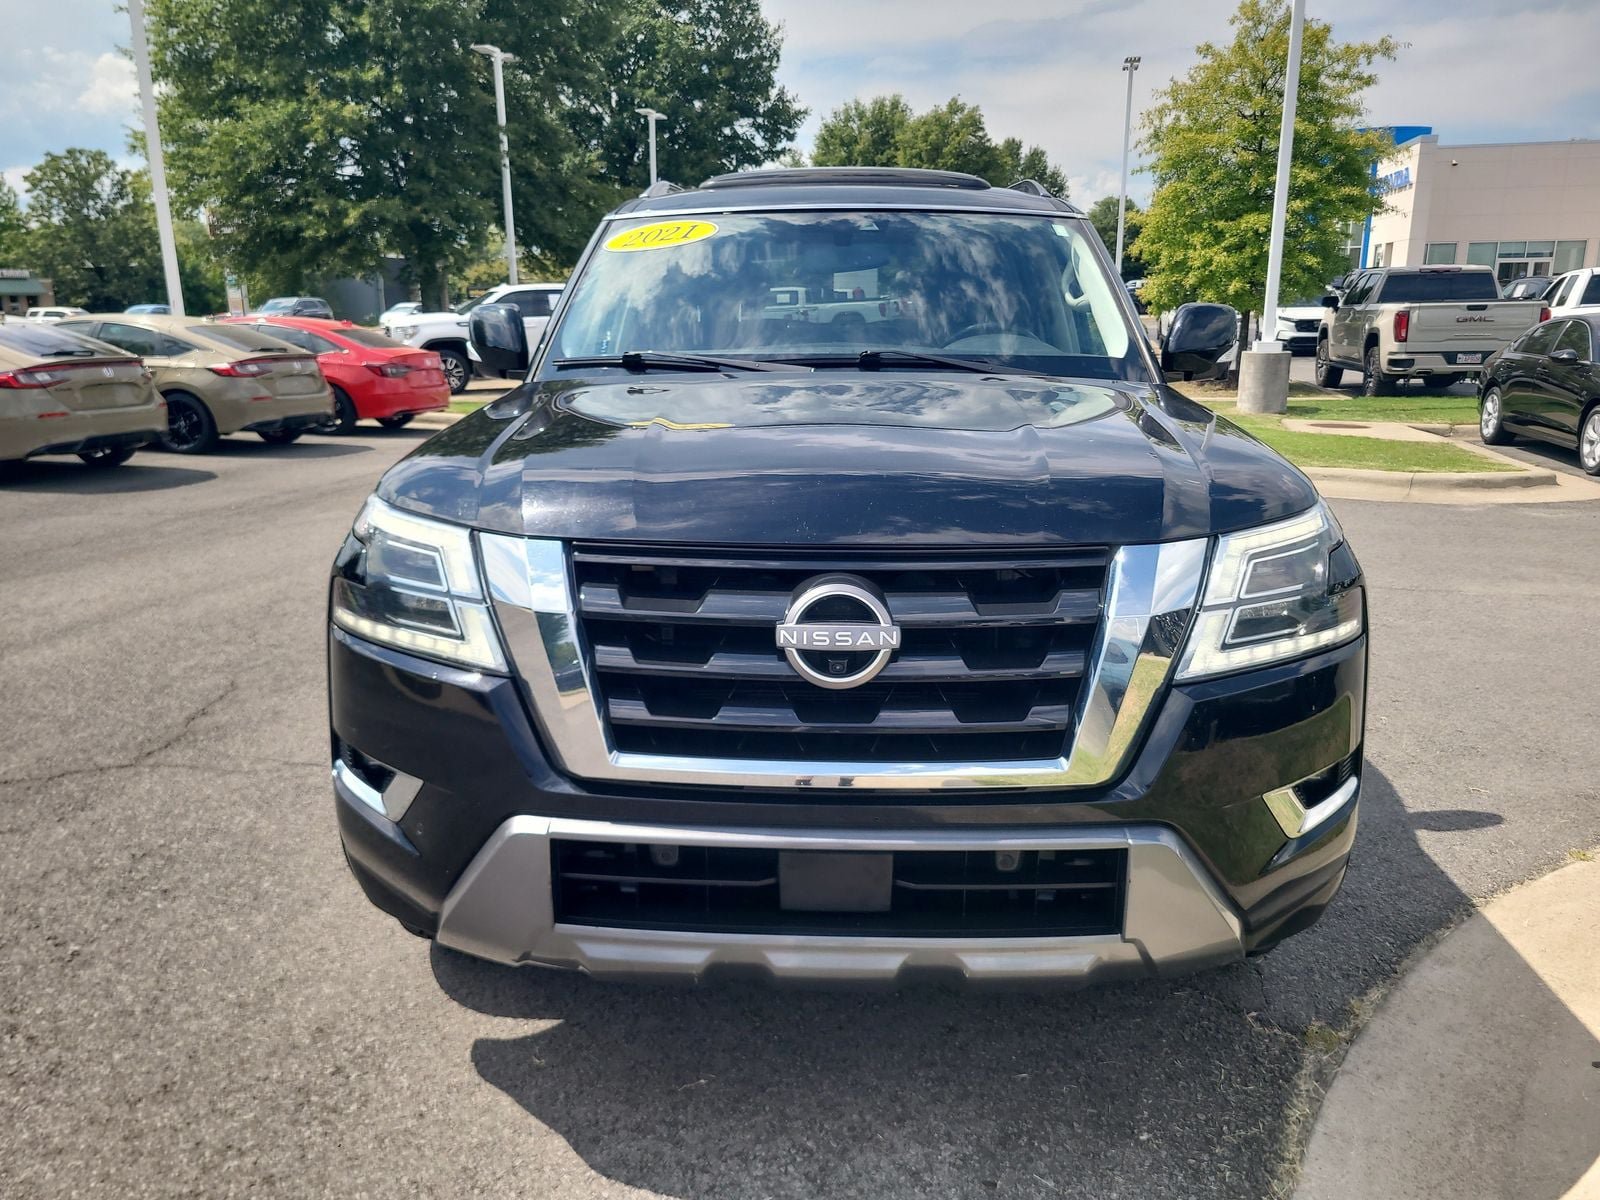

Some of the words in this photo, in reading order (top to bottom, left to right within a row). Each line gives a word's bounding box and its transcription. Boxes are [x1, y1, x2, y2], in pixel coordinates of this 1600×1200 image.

[622, 224, 698, 247] 2021
[1456, 315, 1495, 323] GMC
[779, 629, 897, 646] NISSAN
